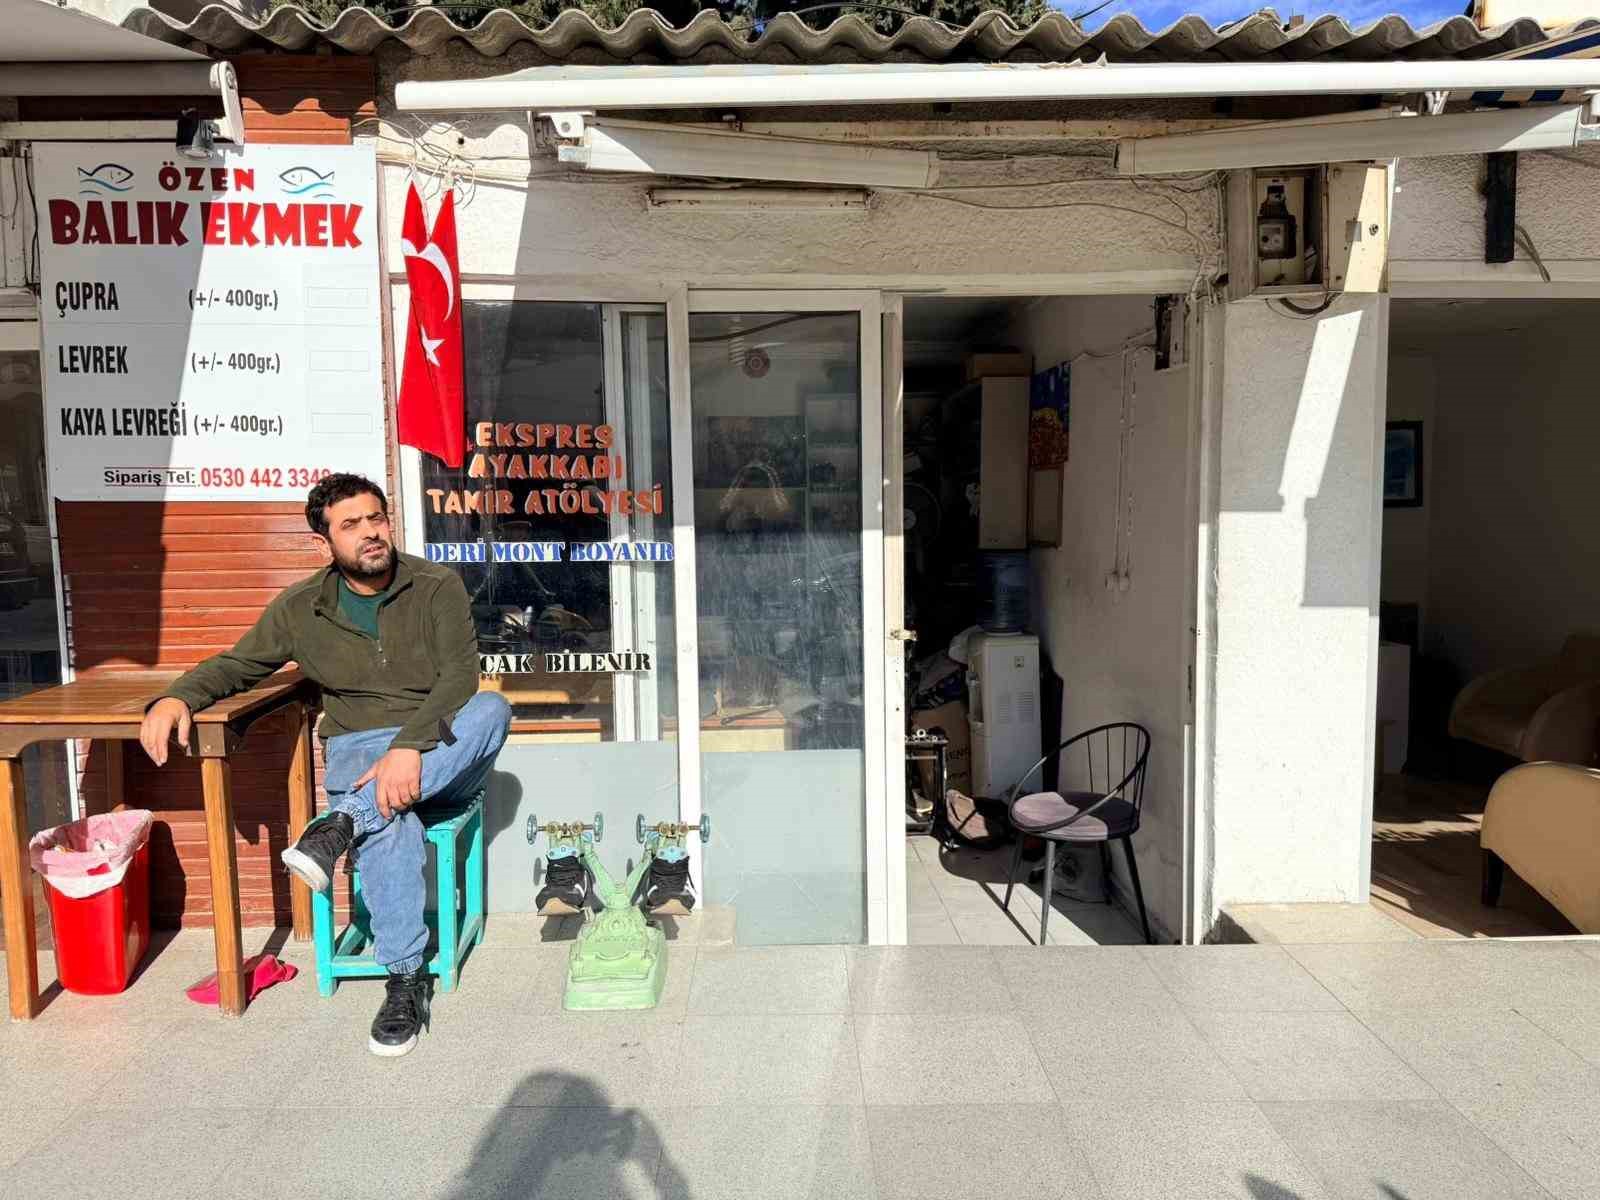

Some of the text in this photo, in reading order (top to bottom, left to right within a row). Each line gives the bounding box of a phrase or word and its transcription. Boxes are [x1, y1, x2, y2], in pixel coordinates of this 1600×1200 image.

[158, 161, 255, 191] ÖZEN
[48, 199, 363, 249] BALIK EKMEK
[55, 281, 120, 317] ÇUPRA
[225, 289, 279, 310] 400gr.)
[59, 345, 129, 374] LEVREK
[228, 353, 281, 374] 400gr.)
[60, 407, 107, 436] KAYA
[112, 401, 187, 436] LEVREĞİ
[230, 415, 284, 435] 400gr.)
[475, 422, 615, 449] EKSPRES
[104, 470, 163, 487] Sipariş
[166, 470, 196, 484] Tel:
[200, 467, 245, 487] 0530
[250, 468, 284, 488] 442
[468, 454, 623, 479] AYAKKABI
[426, 482, 664, 515] TAMİR ATÖLYESİ
[492, 542, 566, 562] MONT
[570, 541, 674, 561] BOYANIR
[546, 648, 652, 672] BİLENİR
